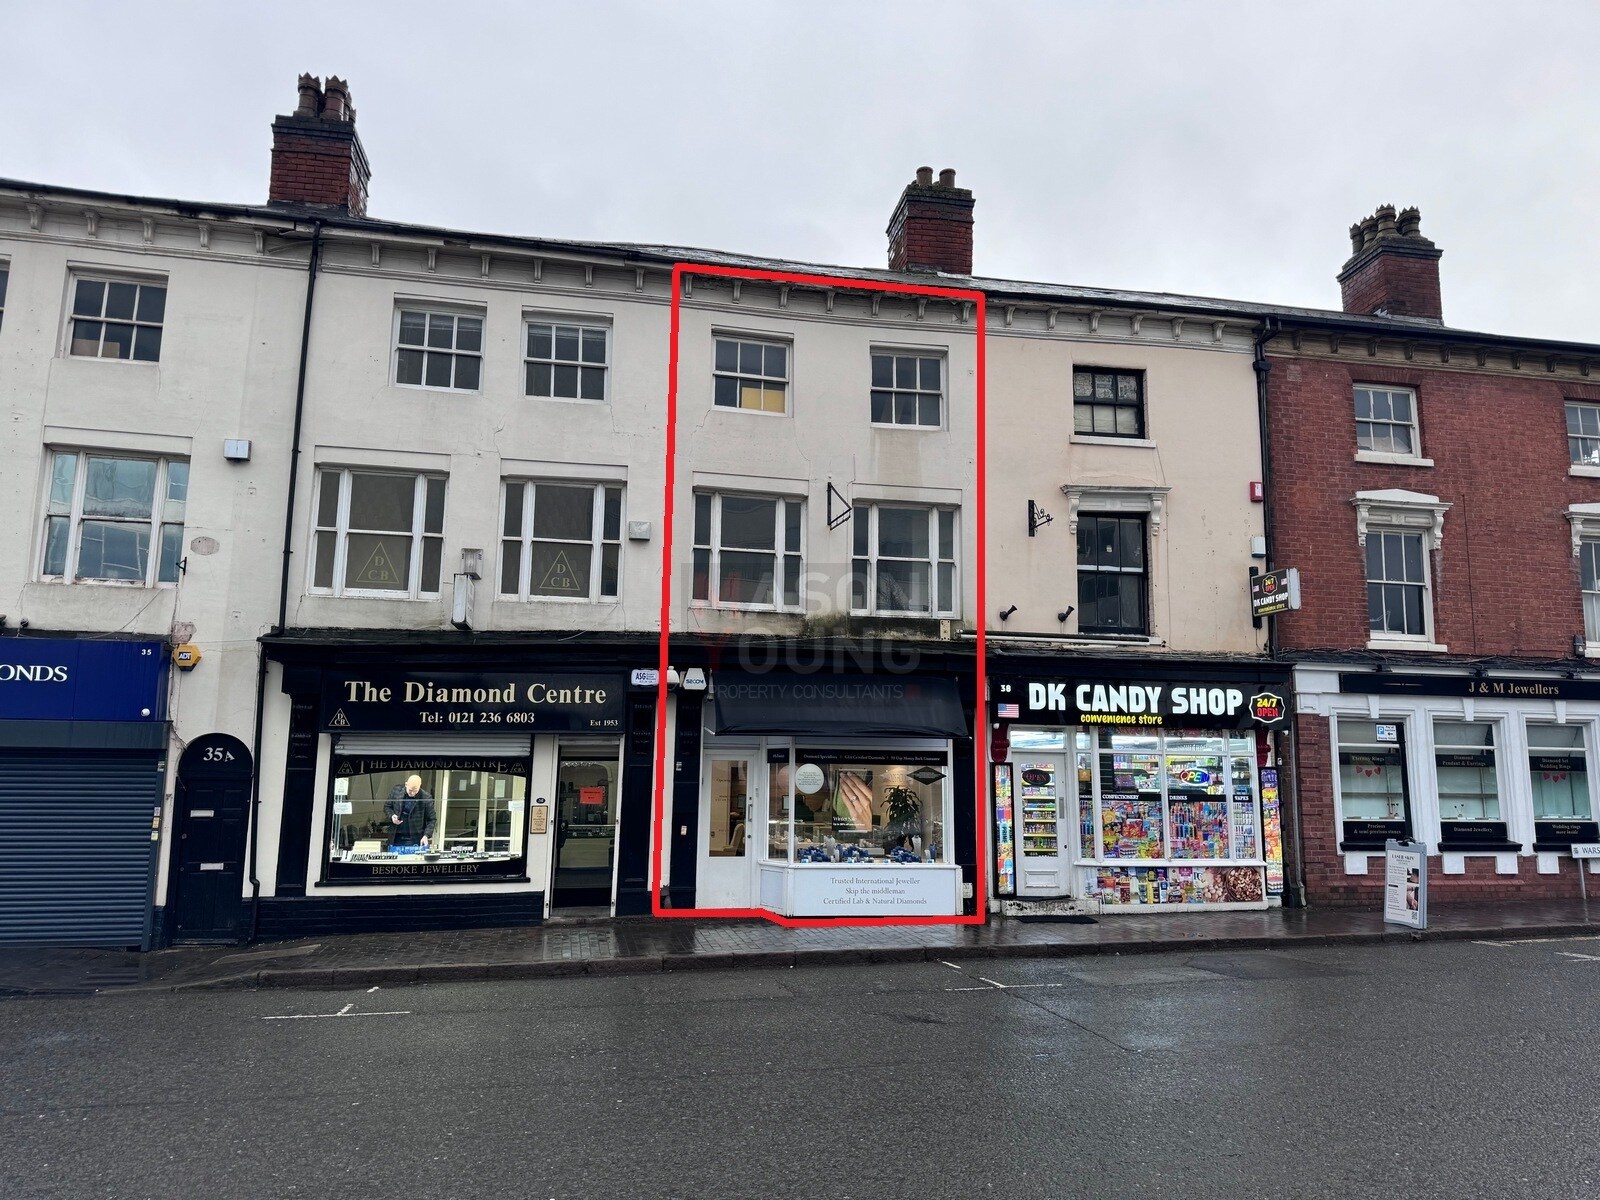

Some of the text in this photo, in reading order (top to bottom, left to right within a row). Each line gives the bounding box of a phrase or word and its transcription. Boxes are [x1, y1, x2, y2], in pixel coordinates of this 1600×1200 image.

[375, 556, 385, 566] D
[557, 564, 566, 574] D
[178, 652, 192, 660] ADT
[635, 672, 646, 680] ASG
[344, 681, 607, 704] The Diamond Centre
[1001, 684, 1012, 692] 38
[1468, 682, 1560, 695] J & M Jewellers
[1029, 683, 1243, 716] DK CANDY SHOP
[1257, 698, 1278, 708] 24/7
[419, 711, 535, 723] Tel: 0121 236 6803
[1257, 708, 1278, 717] OPEN
[1080, 714, 1163, 725] convenience store
[356, 759, 509, 774] THE DIAMOND CENTRE
[1180, 771, 1211, 782] OPEN
[372, 865, 479, 875] BESPOKE JEWELLERY
[855, 877, 895, 885] International
[895, 877, 921, 886] Jeweller
[845, 887, 859, 896] Skip
